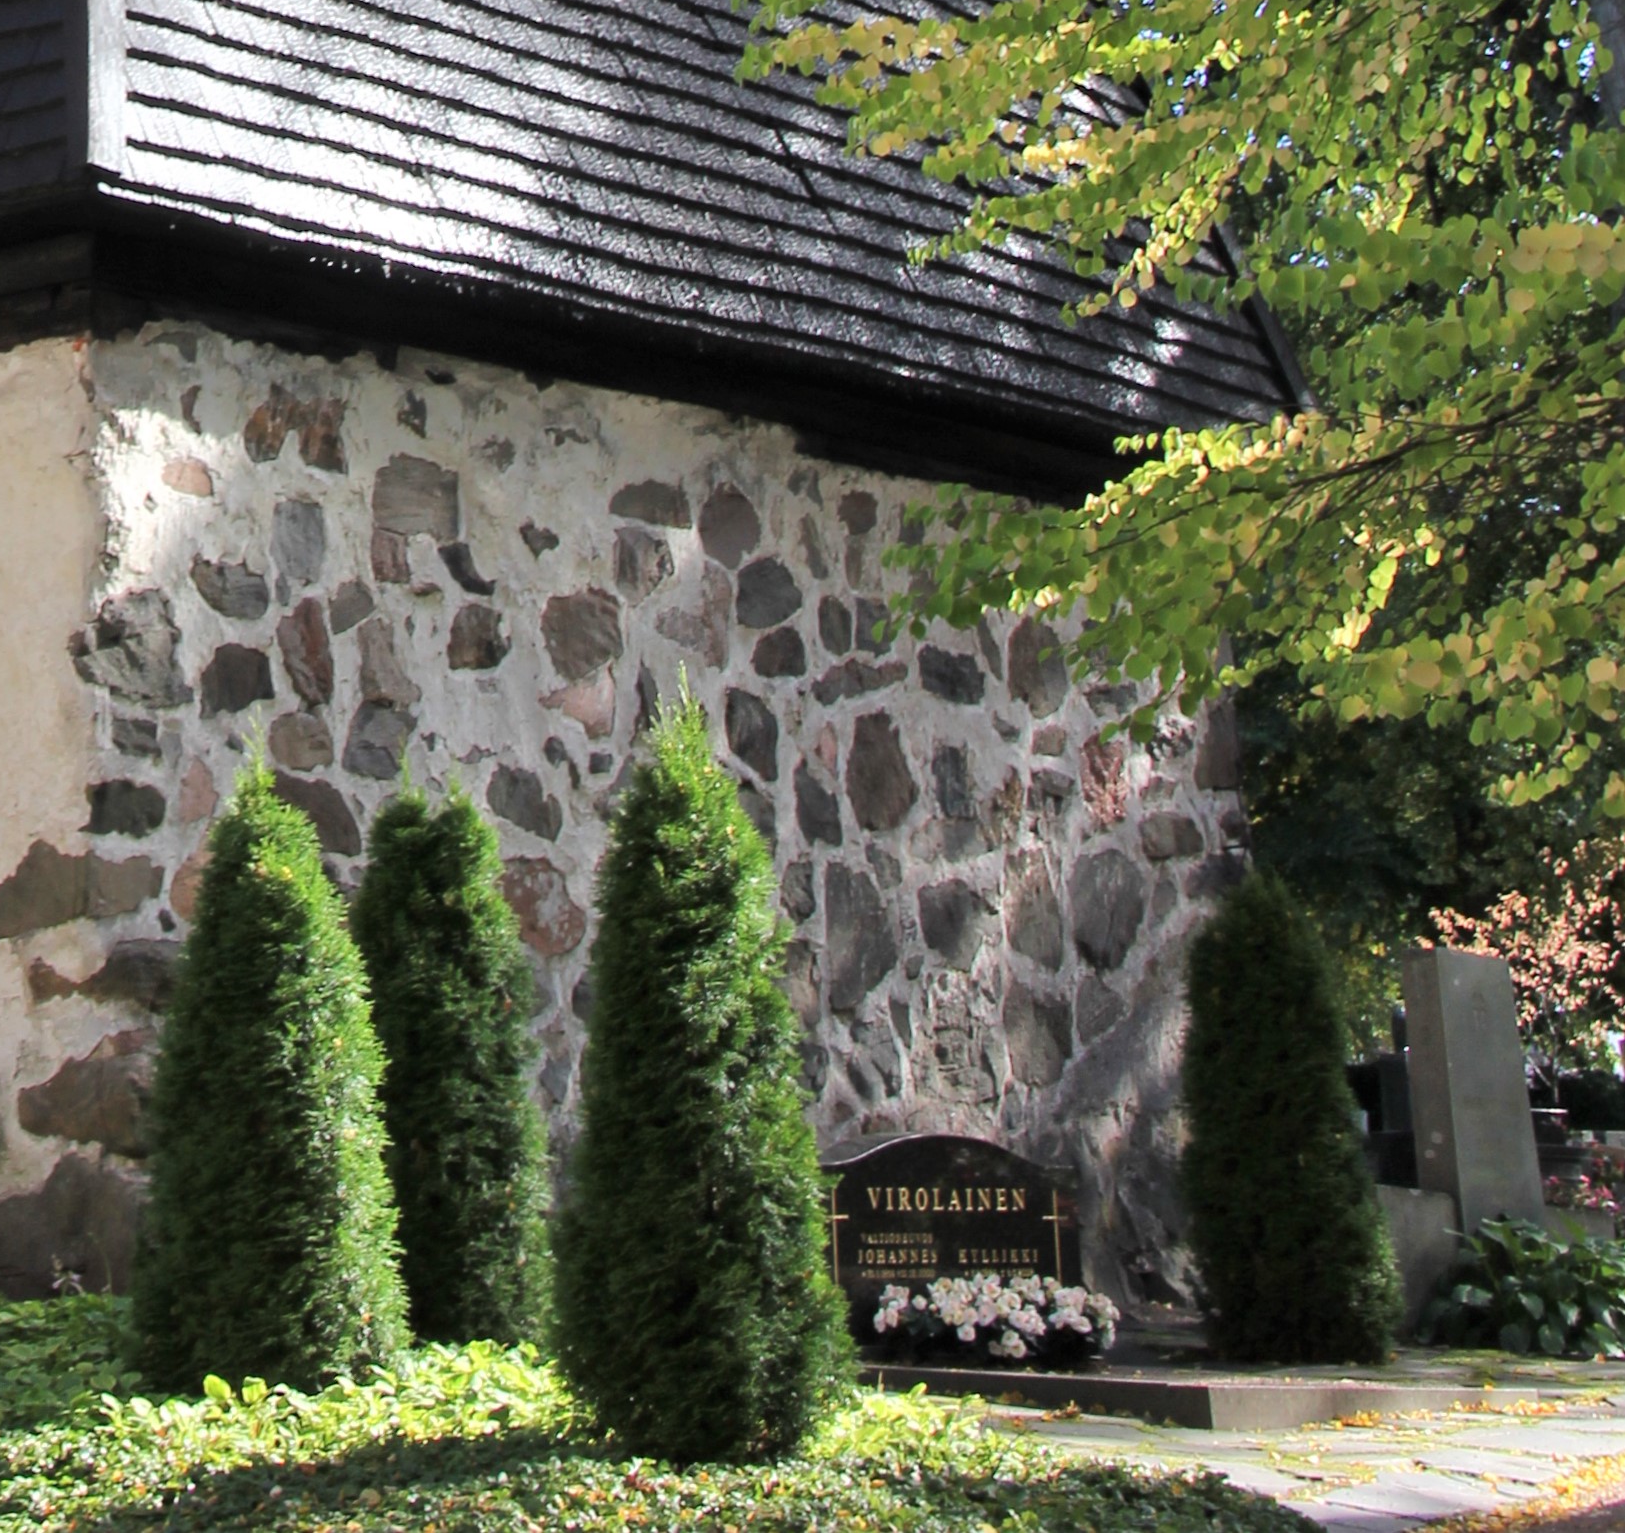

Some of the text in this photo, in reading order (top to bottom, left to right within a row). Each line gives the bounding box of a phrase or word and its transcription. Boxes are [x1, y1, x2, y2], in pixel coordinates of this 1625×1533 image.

[867, 1187, 1027, 1212] VIROLAINEN
[857, 1249, 938, 1264] JOHANNES
[958, 1249, 1039, 1264] KYLLIKKI
